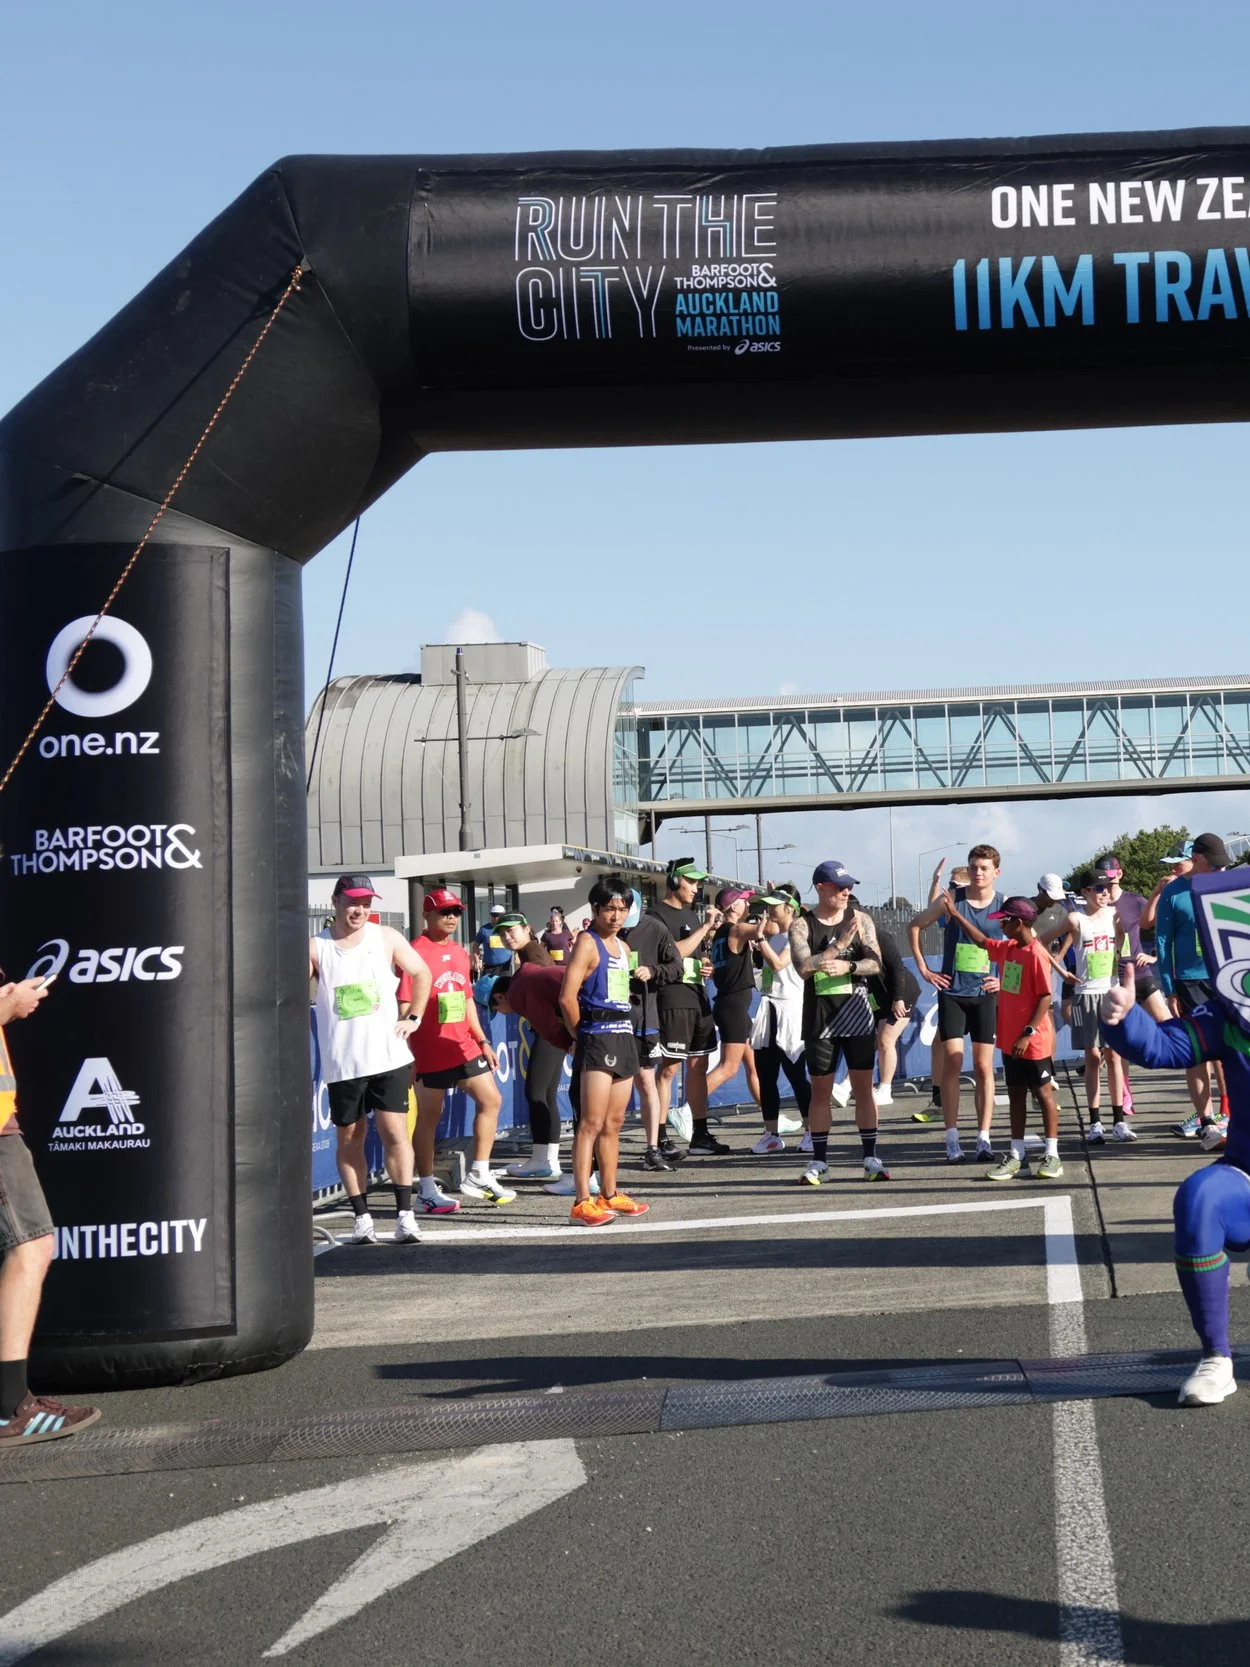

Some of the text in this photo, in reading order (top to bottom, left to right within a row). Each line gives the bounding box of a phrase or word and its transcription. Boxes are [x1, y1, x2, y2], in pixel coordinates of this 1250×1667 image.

[991, 183, 1076, 229] ONE
[1089, 179, 1186, 225] NEW
[515, 192, 777, 261] RUN THE
[674, 275, 758, 289] THOMPSON
[953, 253, 1095, 331] 11KM
[516, 265, 666, 341] CITY
[675, 291, 779, 315] AUCKLAND
[675, 314, 781, 337] MARATHON
[38, 731, 160, 759] one.nz
[10, 846, 163, 876] THOMPSON
[52, 1122, 145, 1139] AUCKLAND
[87, 1138, 151, 1150] MAKAURAU
